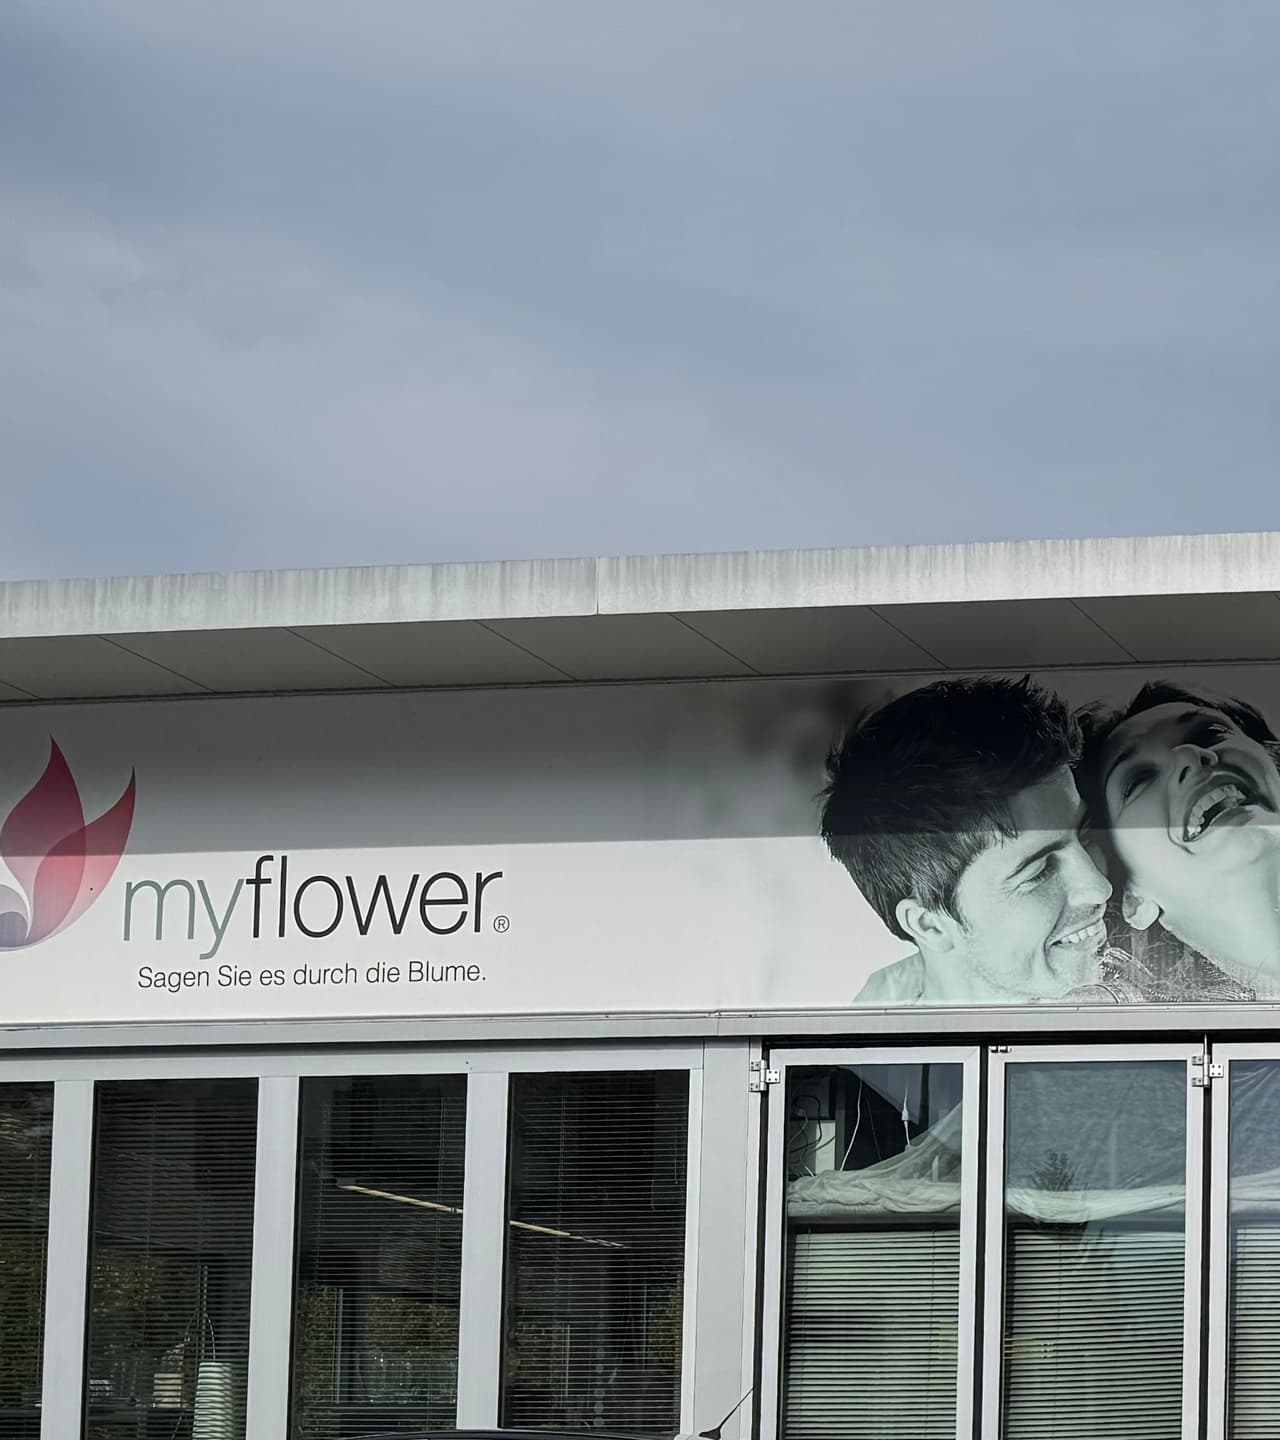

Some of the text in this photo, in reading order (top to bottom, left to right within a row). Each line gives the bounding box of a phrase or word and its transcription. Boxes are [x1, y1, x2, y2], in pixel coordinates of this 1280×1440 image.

[137, 960, 487, 994] Sagen Sie es durch die Blume.
